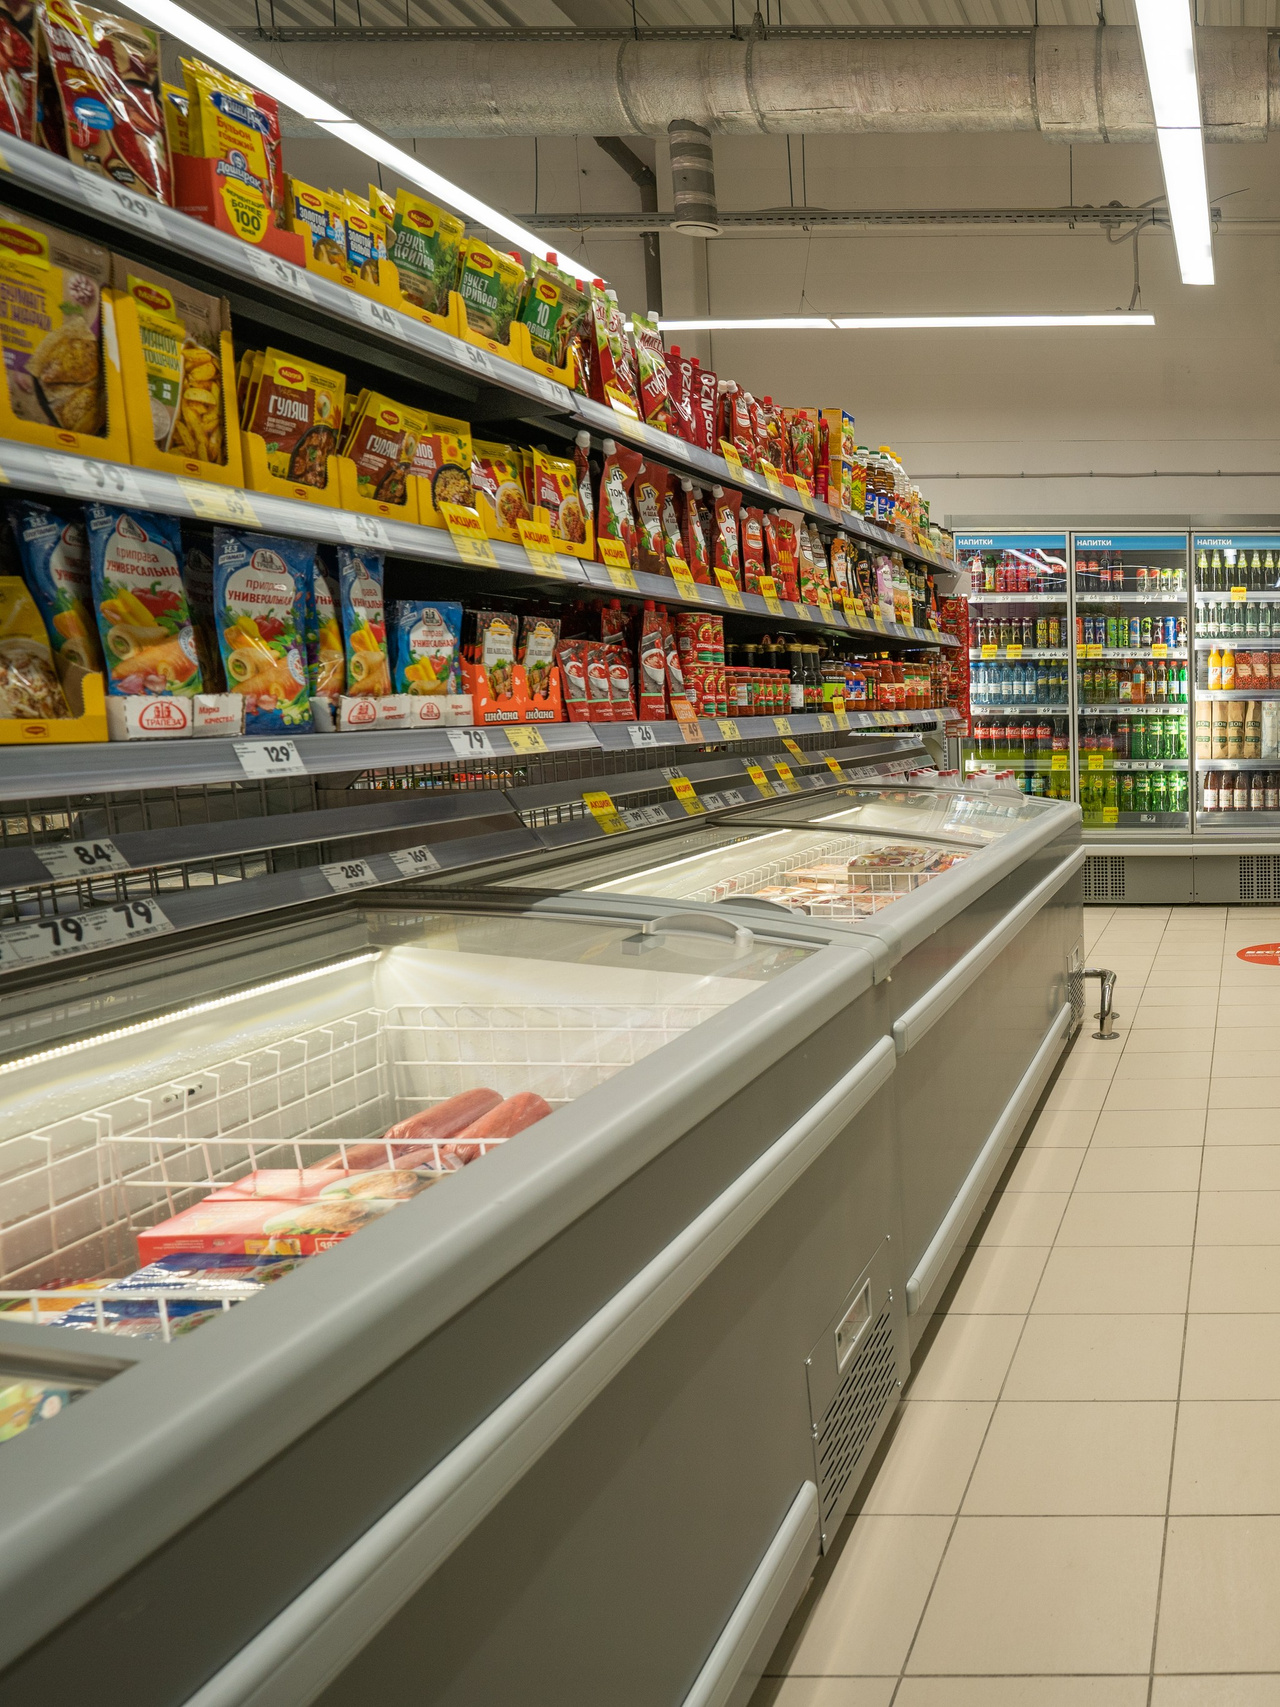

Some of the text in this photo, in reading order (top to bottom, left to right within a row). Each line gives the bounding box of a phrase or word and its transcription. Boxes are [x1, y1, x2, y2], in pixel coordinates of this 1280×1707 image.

[217, 161, 263, 192] Доширак
[113, 188, 147, 218] 129
[231, 198, 263, 217] БОЛЕЕ
[235, 209, 260, 231] 100
[270, 257, 297, 286] 37
[463, 271, 489, 292] БУКЕТ
[461, 286, 498, 309] ПРИПРАВ
[371, 303, 396, 325] 44
[536, 302, 550, 326] 10
[467, 344, 486, 367] 54
[268, 394, 309, 423] ГУЛЯШ
[366, 434, 399, 460] ГУЛЯШ
[85, 462, 124, 492] 99
[225, 500, 244, 515] 59
[356, 516, 379, 538] 49
[450, 513, 482, 531] АКЦИЯ!
[523, 529, 550, 545] АКЦИЯ!
[958, 538, 993, 547] НАПИТКИ
[1077, 539, 1112, 547] НАПИТКИ
[1197, 538, 1232, 547] НАПИТКИ
[116, 546, 160, 564] приправа
[223, 544, 238, 554] БЕЗ
[472, 538, 490, 558] 54
[603, 547, 626, 560] АКЦИЯ!
[671, 565, 691, 577] АКЦИЯ!
[719, 576, 737, 587] АКЦИЯ!
[199, 705, 221, 715] Марка
[204, 713, 235, 725] качества!
[484, 708, 520, 722] индана
[144, 716, 183, 728] ТРАПЕЗА
[688, 723, 700, 737] 49
[462, 730, 485, 749] 79
[527, 734, 541, 746] 34
[637, 726, 651, 741] 26
[263, 744, 291, 763] 129
[675, 783, 693, 794] АКЦИЯ!
[589, 798, 612, 810] АКЦИЯ!
[630, 810, 642, 822] 199
[73, 843, 113, 865] 84
[408, 849, 429, 864] 169
[340, 863, 366, 879] 289
[113, 901, 153, 929] 79
[38, 917, 83, 946] 79
